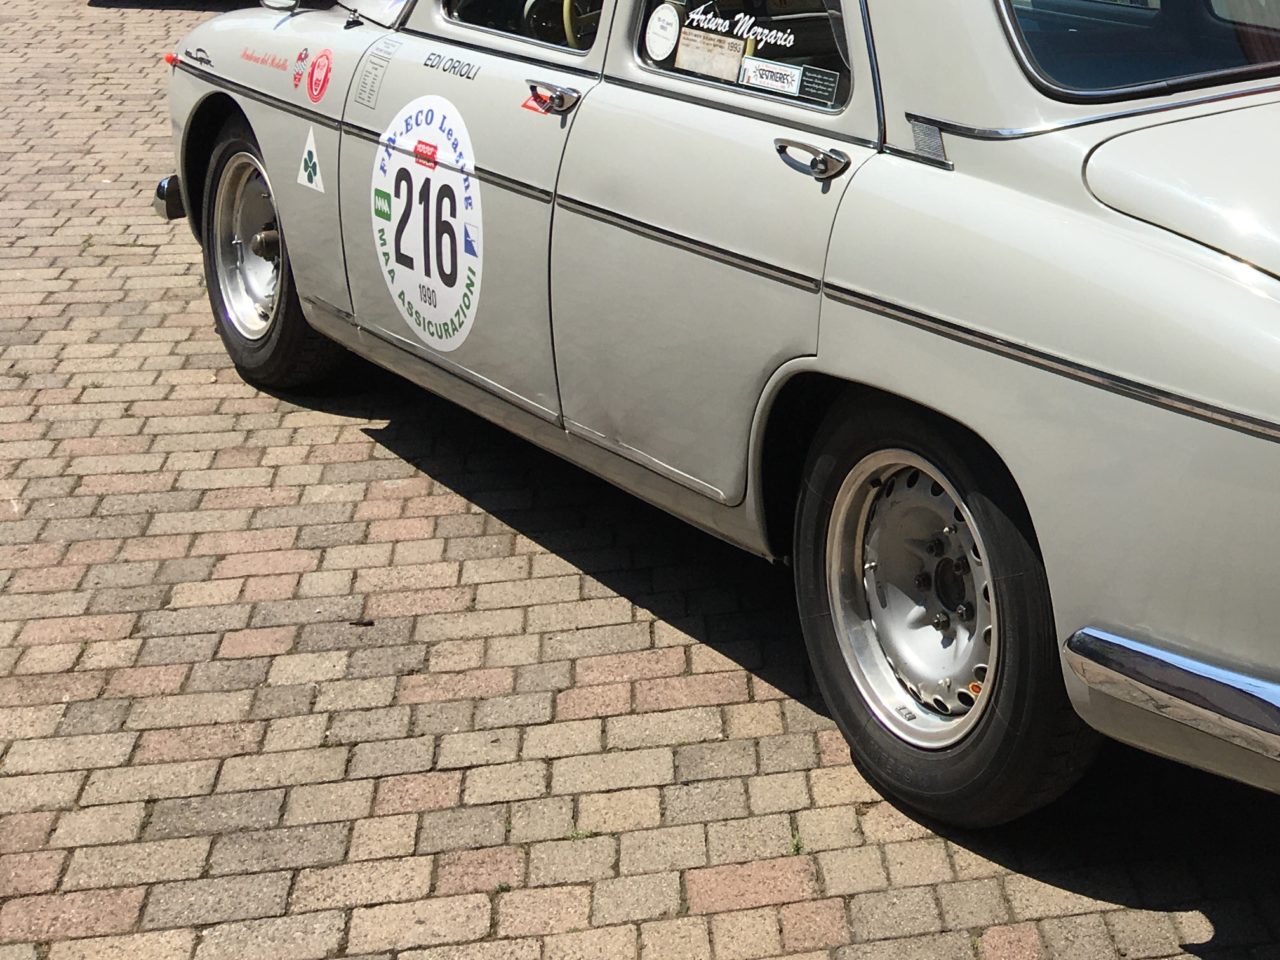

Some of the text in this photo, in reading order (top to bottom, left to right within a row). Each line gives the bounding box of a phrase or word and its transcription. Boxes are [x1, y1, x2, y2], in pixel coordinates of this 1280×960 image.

[684, 5, 731, 33] Arturo
[733, 12, 795, 50] Merzario
[423, 52, 482, 81] EDI ORIOLI
[394, 167, 458, 289] 216
[377, 228, 396, 285] MAA
[398, 266, 476, 340] ASSICURAZIONI
[418, 283, 438, 309] 1990
